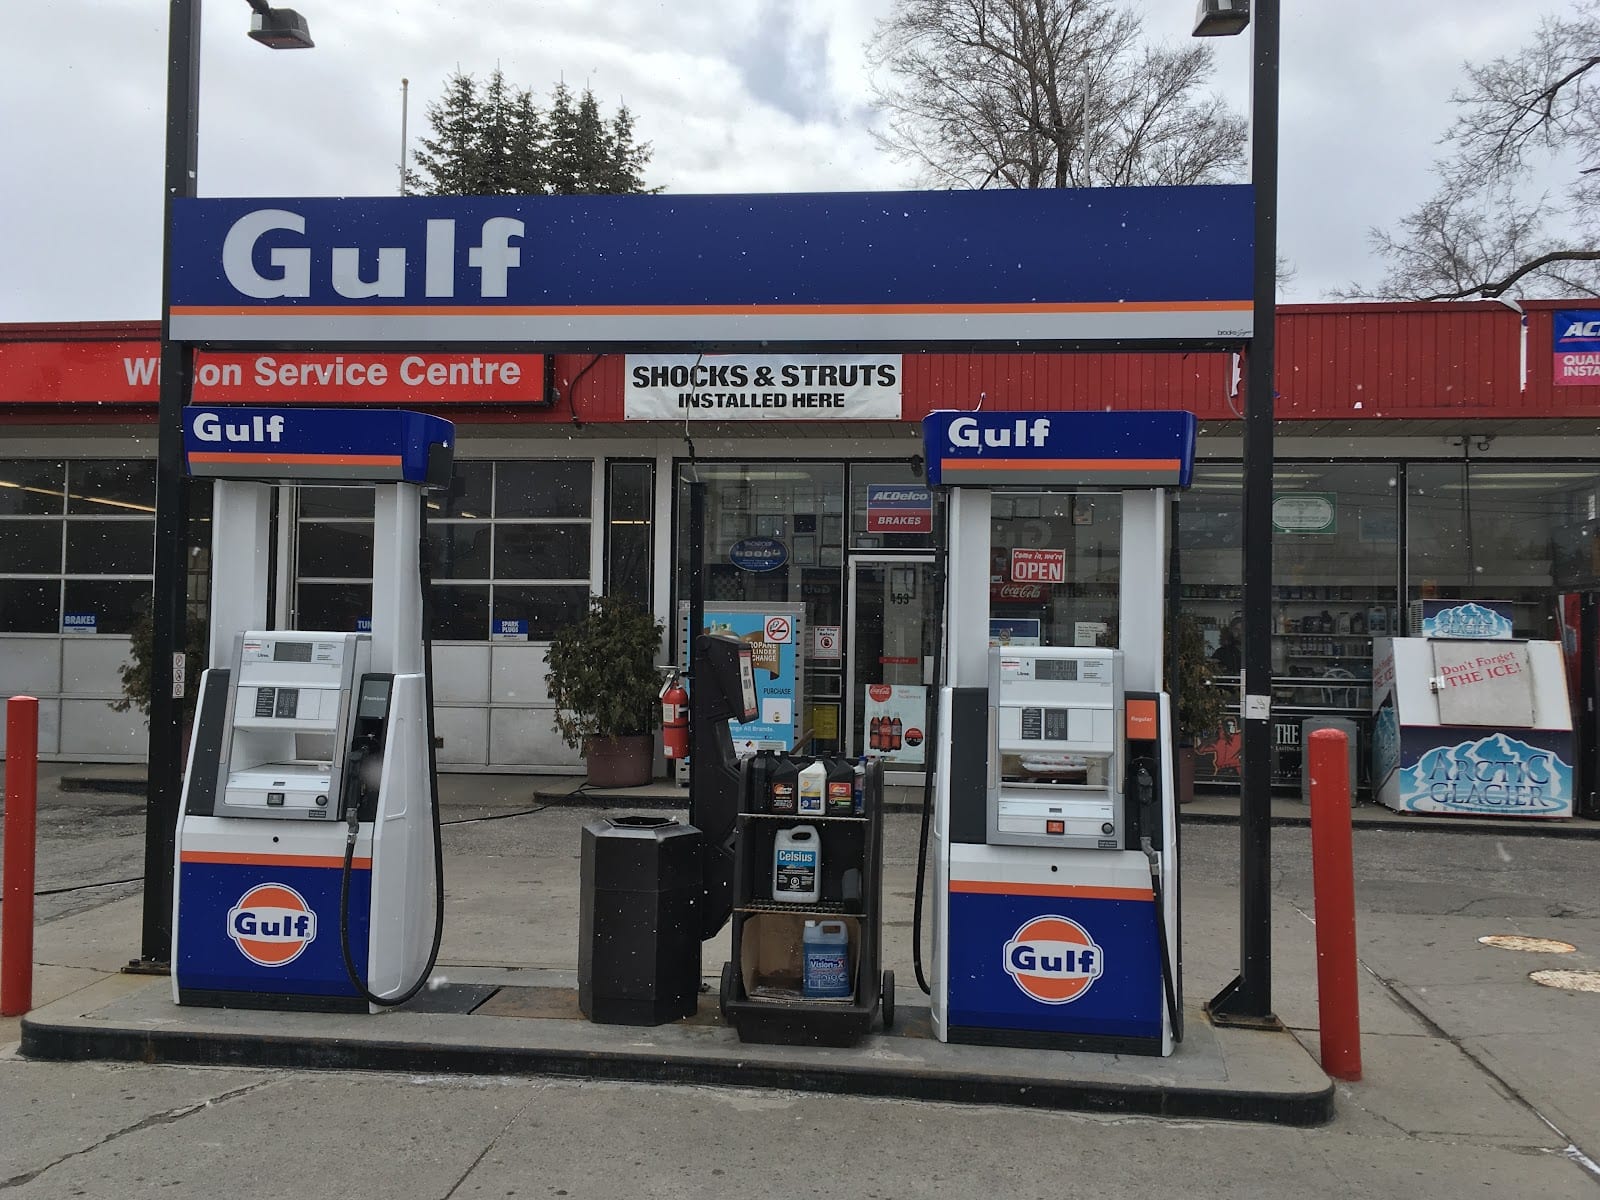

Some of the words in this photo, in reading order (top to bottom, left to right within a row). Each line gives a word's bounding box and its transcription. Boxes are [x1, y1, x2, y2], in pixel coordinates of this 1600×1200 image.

[222, 209, 525, 299] Gulf
[1563, 321, 1600, 337] AC
[254, 356, 388, 386] Service
[400, 355, 521, 385] Centre
[632, 365, 749, 388] SHOCKS
[753, 365, 776, 387] &
[781, 364, 896, 387] STRUTS
[678, 393, 788, 408] INSTALLED
[791, 392, 845, 408] HERE
[192, 412, 285, 442] Gulf
[947, 418, 1051, 448] Gulf
[873, 491, 928, 501] ACDelco
[878, 516, 921, 525] BRAKES
[1014, 551, 1032, 559] Come
[1034, 551, 1043, 560] in,
[1015, 562, 1061, 580] OPEN
[64, 615, 96, 625] BRAKES
[1440, 614, 1493, 625] ARCTIC
[1441, 623, 1491, 634] GLACIER
[1440, 660, 1474, 676] Don't
[1476, 651, 1516, 667] Forget
[1446, 670, 1484, 688] THE
[1487, 662, 1523, 679] ICE!
[763, 687, 792, 695] PURCHASE
[1131, 715, 1153, 723] Regular
[1274, 723, 1300, 745] THE
[1428, 751, 1549, 785] ARCTIC
[1430, 782, 1549, 807] GLACIER
[779, 850, 813, 862] Celsius
[234, 913, 309, 937] Gulf
[1011, 945, 1095, 973] Gulf
